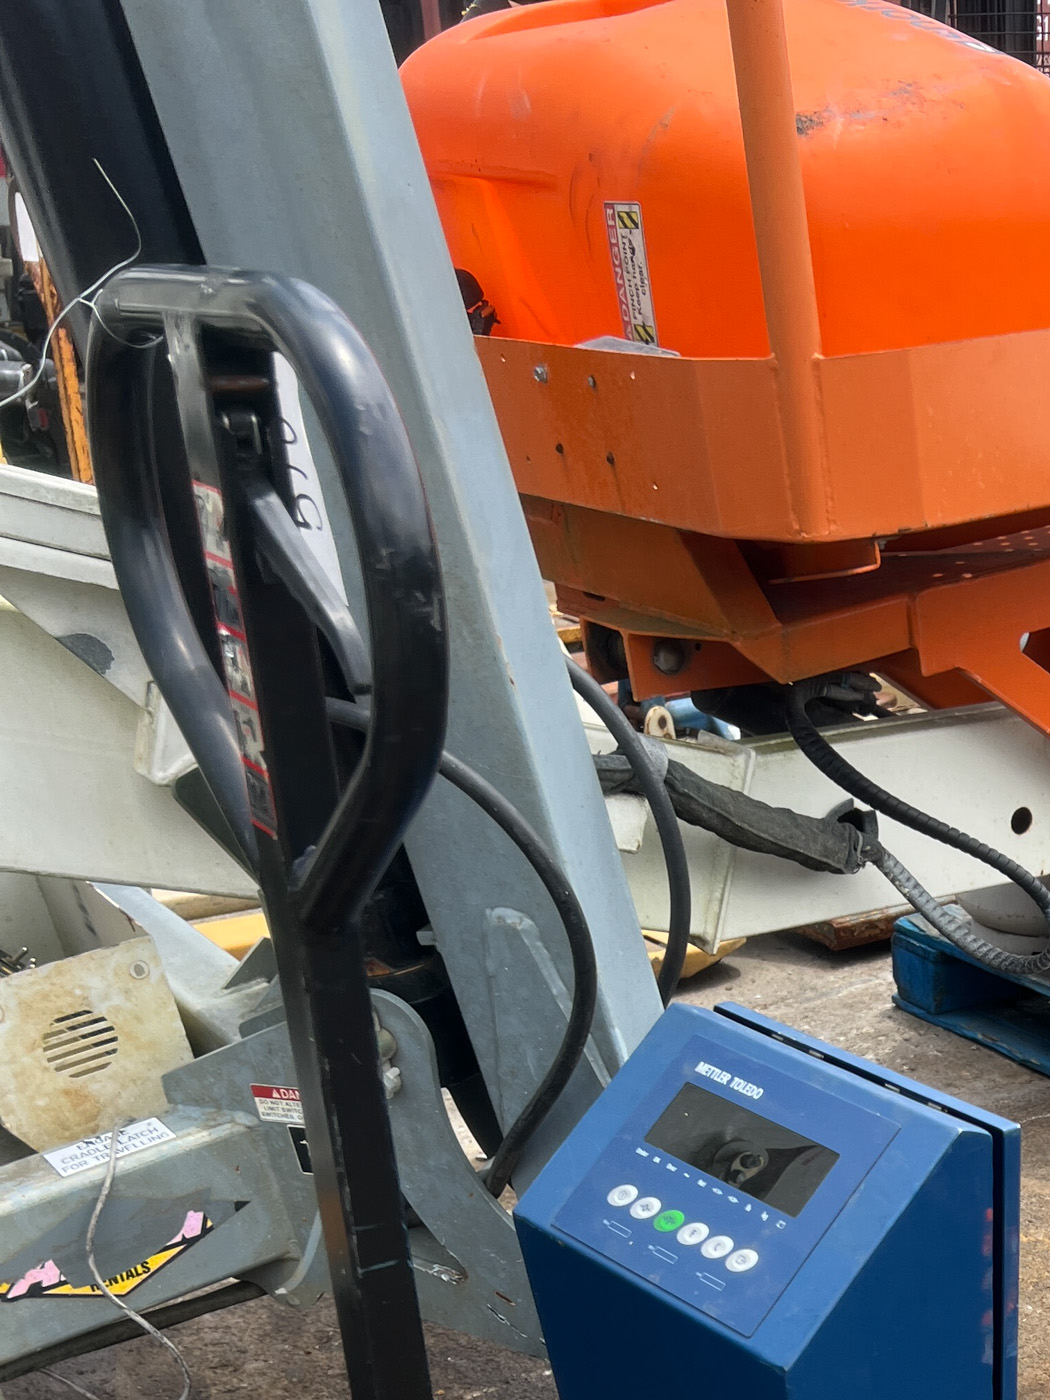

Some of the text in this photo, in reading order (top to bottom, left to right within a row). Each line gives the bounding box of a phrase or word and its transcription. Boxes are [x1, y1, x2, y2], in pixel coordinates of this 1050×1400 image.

[606, 207, 630, 321] DANGER
[621, 232, 638, 320] PINCH POINT
[635, 283, 643, 316] Keep
[280, 1089, 300, 1100] DAN
[694, 1061, 764, 1100] METTLER TOLEDO
[60, 1126, 159, 1165] CRADLE LATCH
[61, 1160, 89, 1173] FOR
